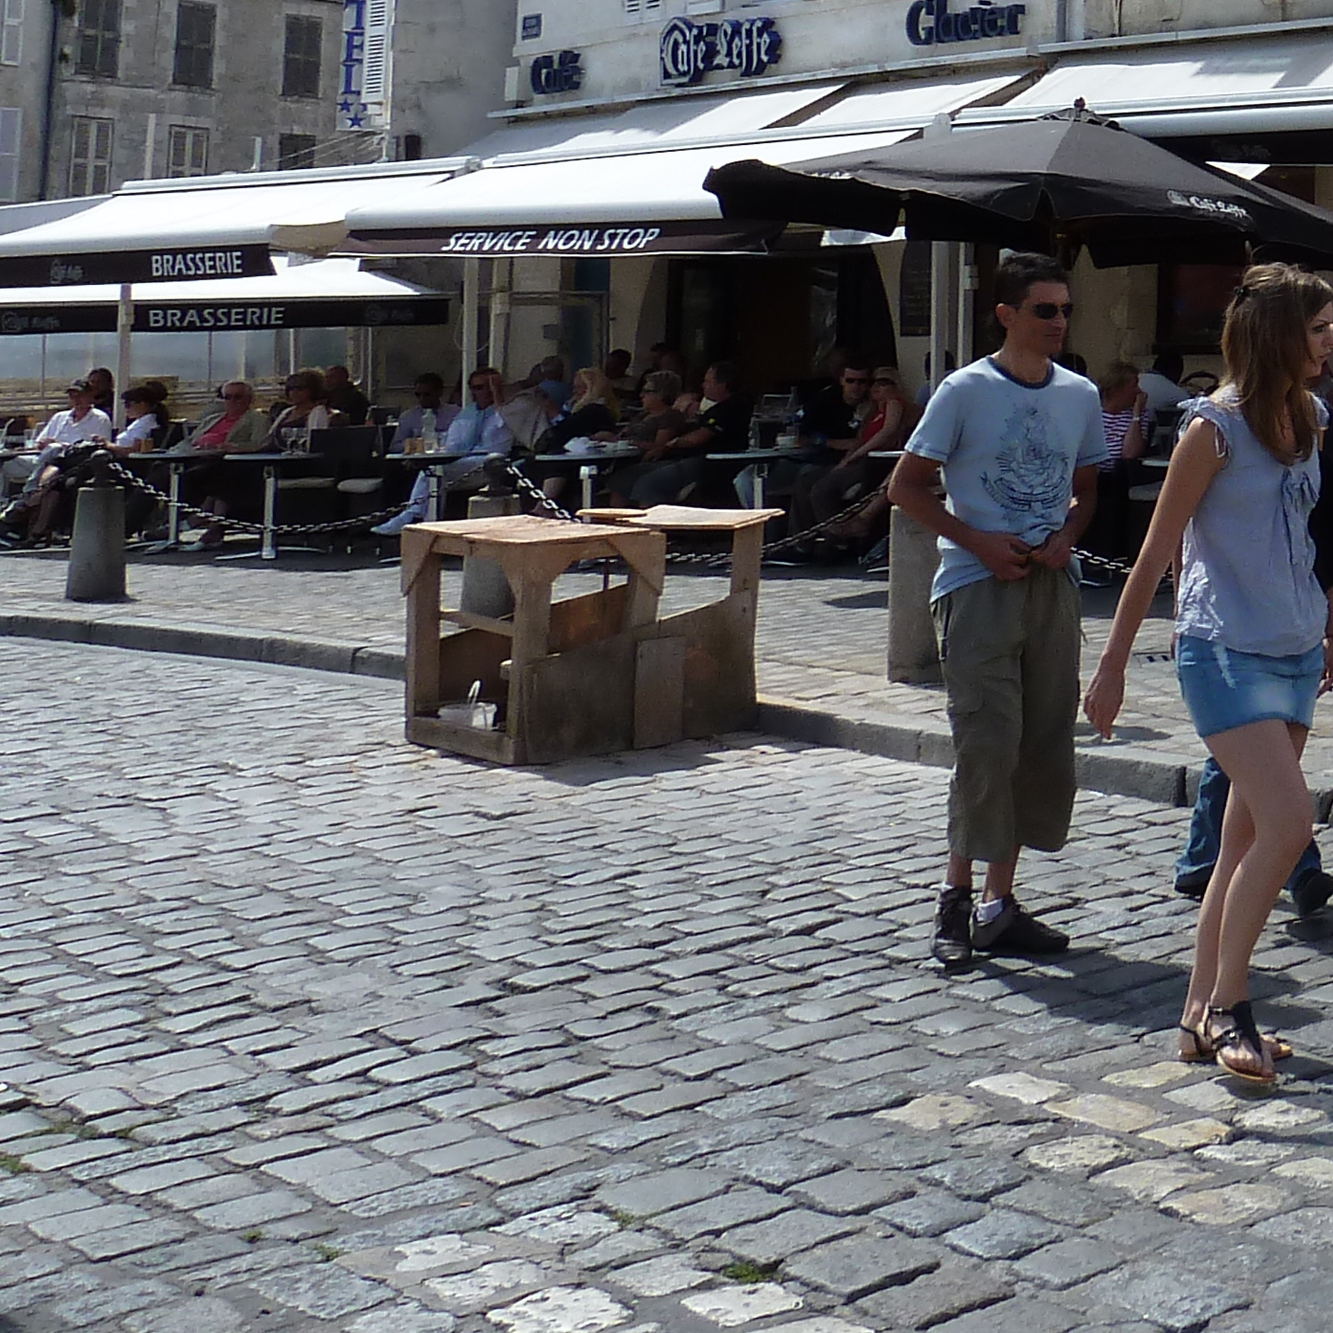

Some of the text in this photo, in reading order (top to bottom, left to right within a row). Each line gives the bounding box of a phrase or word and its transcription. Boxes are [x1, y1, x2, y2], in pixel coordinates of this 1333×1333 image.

[712, 18, 774, 76] Leffe
[441, 228, 661, 252] SERVICE NON STOP
[151, 251, 243, 277] BRASSERIE
[149, 307, 286, 328] BRASSERIE
